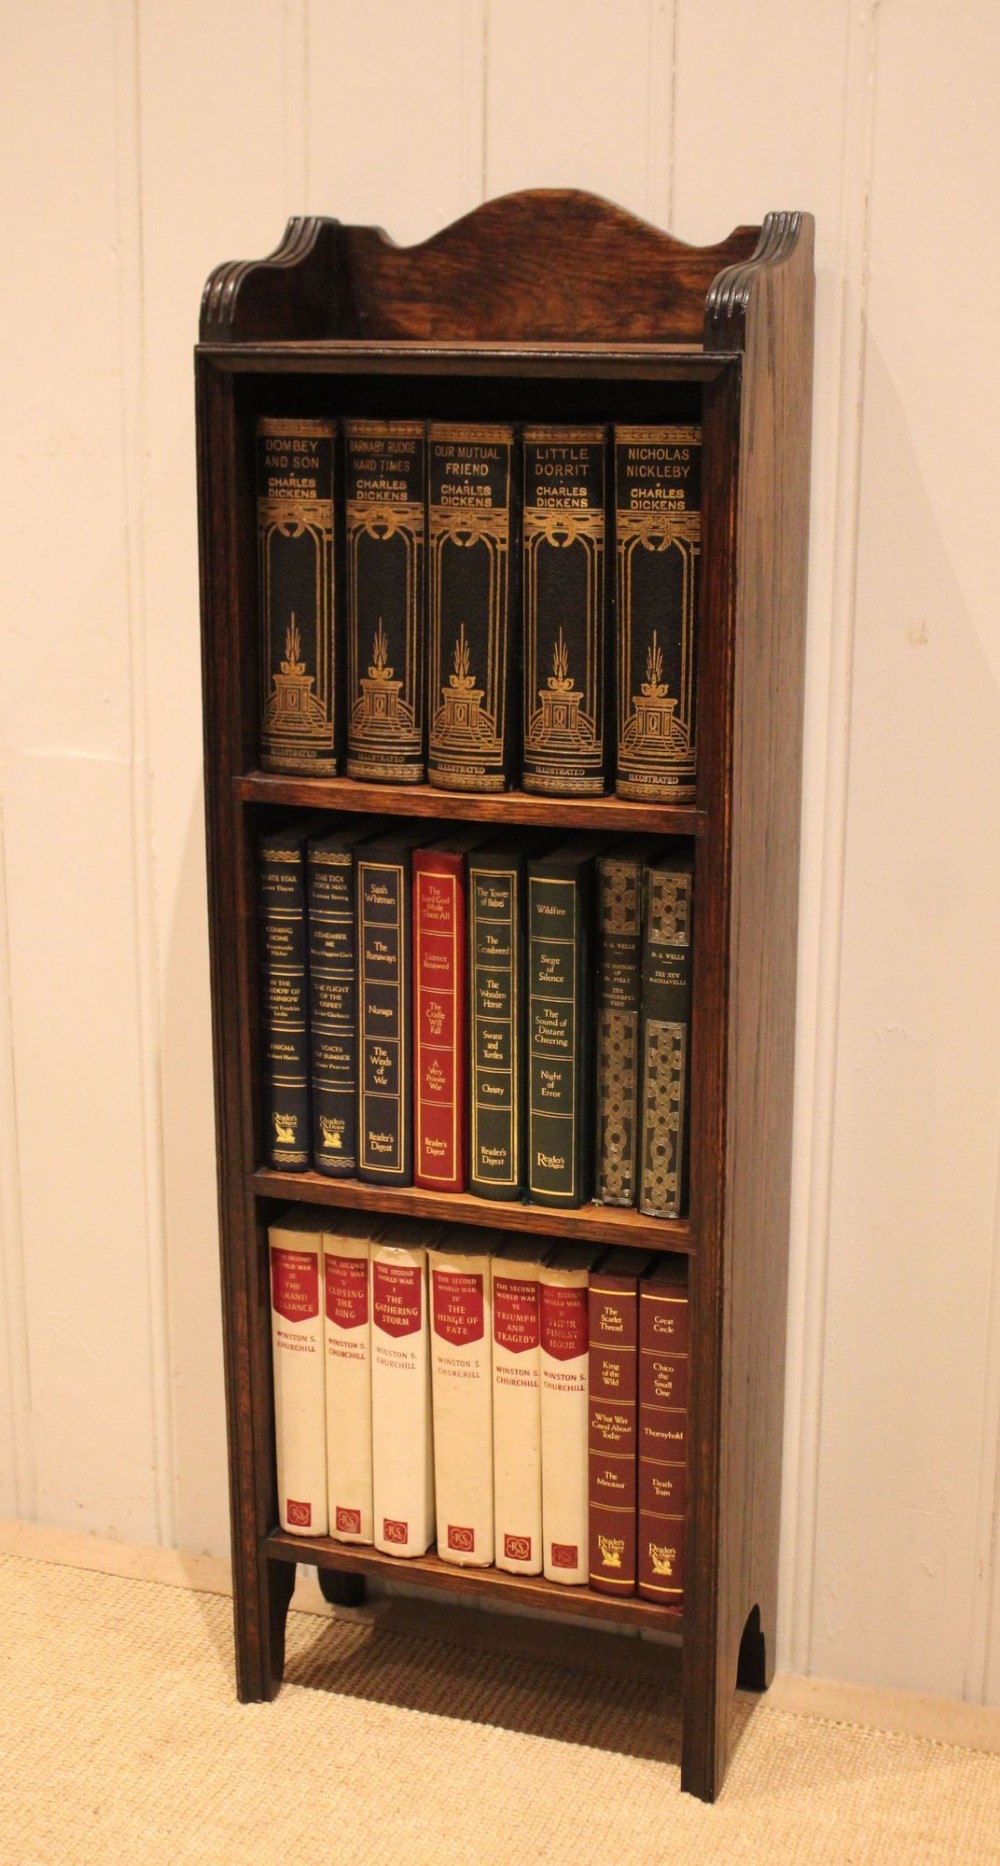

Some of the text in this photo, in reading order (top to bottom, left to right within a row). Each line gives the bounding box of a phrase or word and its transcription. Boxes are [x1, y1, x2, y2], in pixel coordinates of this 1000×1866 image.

[265, 439, 318, 452] DOMBEY
[350, 441, 416, 454] BARNABY RUDGE
[434, 445, 500, 459] OUR MUTUAL
[536, 448, 589, 460] LITTLE
[628, 448, 690, 460] NICHOLAS
[265, 456, 319, 469] AND SON
[353, 459, 410, 472] HARD TIMES
[445, 463, 489, 476] FRIEND
[535, 464, 590, 476] DORRIT
[627, 465, 691, 478] NICKLEBY
[268, 477, 316, 488] CHARLES
[356, 480, 407, 490] CHARLES
[268, 488, 317, 499] DICKENS
[440, 484, 492, 496] CHARLES
[536, 486, 588, 497] CHARLES
[630, 488, 685, 499] CHARLES
[356, 491, 408, 501] DICKENS
[440, 496, 492, 508] DICKENS
[536, 498, 588, 508] DICKENS
[630, 500, 685, 511] DICKENS
[358, 753, 405, 763] ILLUSTRATED
[437, 763, 485, 775] ILLUSTRATED
[535, 766, 585, 776] ILLUSTRATED
[628, 773, 679, 785] ILLUSTRATED
[428, 886, 440, 896] The
[489, 888, 509, 898] Tower
[536, 904, 566, 915] Wildfire
[440, 912, 450, 920] All
[486, 936, 498, 944] The
[374, 941, 388, 952] The
[541, 955, 560, 966] Siege
[539, 972, 564, 983] Silence
[486, 979, 499, 989] The
[480, 989, 506, 999] Wooden
[429, 1002, 441, 1010] The
[483, 999, 502, 1009] Horse
[543, 1009, 559, 1018] The
[429, 1018, 442, 1026] Will
[535, 1016, 567, 1027] Sound of
[430, 1026, 441, 1035] Fall
[483, 1030, 502, 1040] Swans
[539, 1026, 565, 1036] Distant
[487, 1041, 498, 1050] and
[535, 1035, 568, 1047] Cheering
[373, 1046, 387, 1056] The
[483, 1050, 503, 1059] Turtles
[370, 1055, 392, 1066] Winds
[376, 1066, 384, 1075] of
[428, 1066, 443, 1076] Very
[541, 1070, 561, 1080] Night
[374, 1075, 388, 1085] War
[547, 1081, 555, 1089] of
[429, 1082, 442, 1091] War
[482, 1084, 504, 1095] Christy
[541, 1088, 561, 1098] Error
[369, 1131, 394, 1143] Reader's
[371, 1141, 392, 1152] Digest
[426, 1146, 445, 1156] Digest
[481, 1146, 507, 1157] Reader's
[482, 1155, 504, 1166] Digest
[328, 1286, 364, 1298] CLOSING
[438, 1285, 460, 1293] WORLD
[496, 1283, 536, 1293] THE SECOND
[386, 1295, 403, 1304] THE
[496, 1292, 518, 1300] WORLD
[336, 1299, 353, 1308] THE
[335, 1308, 356, 1319] RING
[375, 1302, 418, 1316] GATHERING
[447, 1304, 465, 1314] THE
[604, 1307, 618, 1316] The
[382, 1315, 409, 1326] STORM
[438, 1314, 479, 1324] HINGE OF
[497, 1311, 536, 1323] TRIUMPH
[601, 1314, 622, 1323] Scarlet
[654, 1315, 674, 1325] Great
[446, 1326, 468, 1335] FATE
[506, 1324, 524, 1332] AND
[600, 1322, 623, 1332] Thread
[653, 1324, 674, 1334] Circle
[497, 1332, 535, 1343] TRAGEDY
[328, 1338, 358, 1349] WINSTON
[550, 1340, 575, 1349] HOUR
[329, 1348, 366, 1360] CHURCHILL
[377, 1347, 407, 1359] WINSTON
[377, 1357, 416, 1370] CHURCHILL
[437, 1357, 470, 1367] WINSTON
[603, 1361, 620, 1371] King
[496, 1366, 530, 1376] WINSTON
[653, 1362, 674, 1373] Chico
[437, 1368, 480, 1379] CHURCHILL
[544, 1370, 577, 1381] WINSTON
[609, 1370, 619, 1378] the
[658, 1372, 669, 1380] the
[496, 1376, 539, 1387] CHURCHILL
[544, 1381, 584, 1392] CHURCHILL
[603, 1377, 619, 1386] Wild
[654, 1380, 673, 1389] Small
[655, 1388, 671, 1397] One
[595, 1412, 628, 1424] What Was
[592, 1421, 632, 1432] Good About
[602, 1430, 621, 1440] Today
[644, 1427, 684, 1440] Thornyhold
[604, 1471, 618, 1480] The
[597, 1478, 625, 1489] Minotaur
[652, 1478, 673, 1488] Death
[654, 1487, 671, 1497] Train
